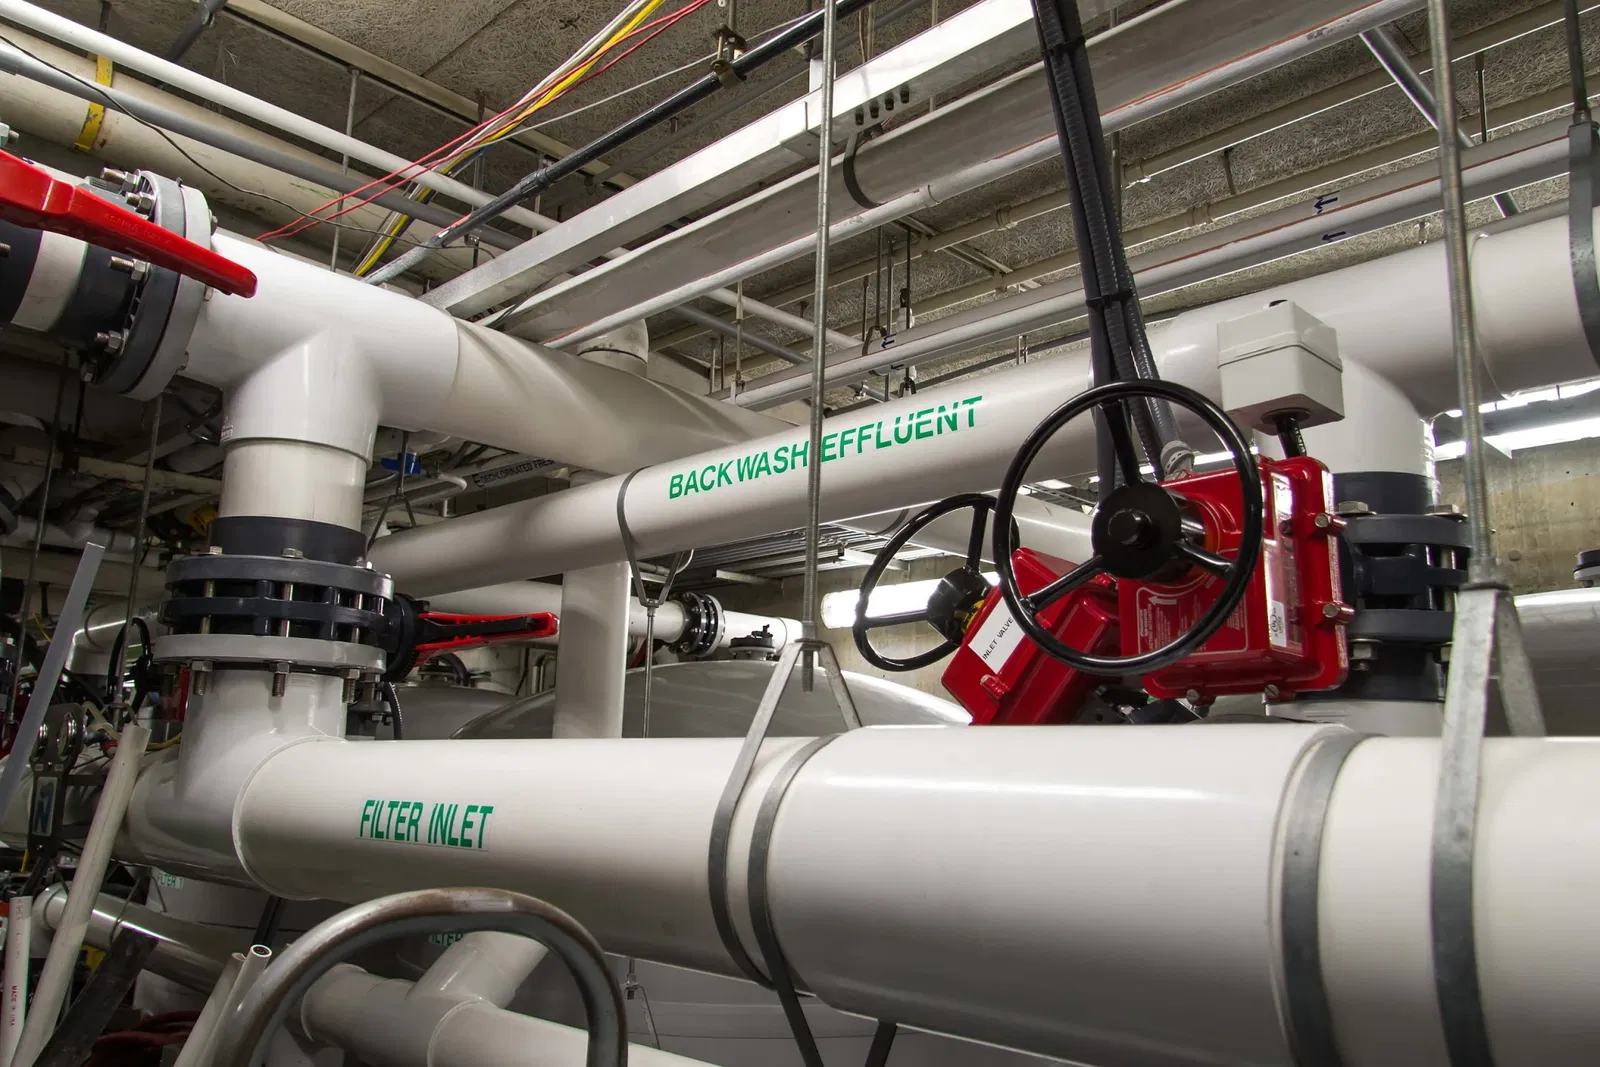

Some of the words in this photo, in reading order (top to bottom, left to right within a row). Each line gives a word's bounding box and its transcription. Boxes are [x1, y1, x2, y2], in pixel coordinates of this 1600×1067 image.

[668, 440, 810, 499] BACKWASH
[821, 395, 983, 462] EFFLUENT
[982, 638, 998, 660] INLET
[996, 616, 1014, 638] VALVE
[359, 799, 424, 842] FILTER
[427, 802, 495, 849] INLET
